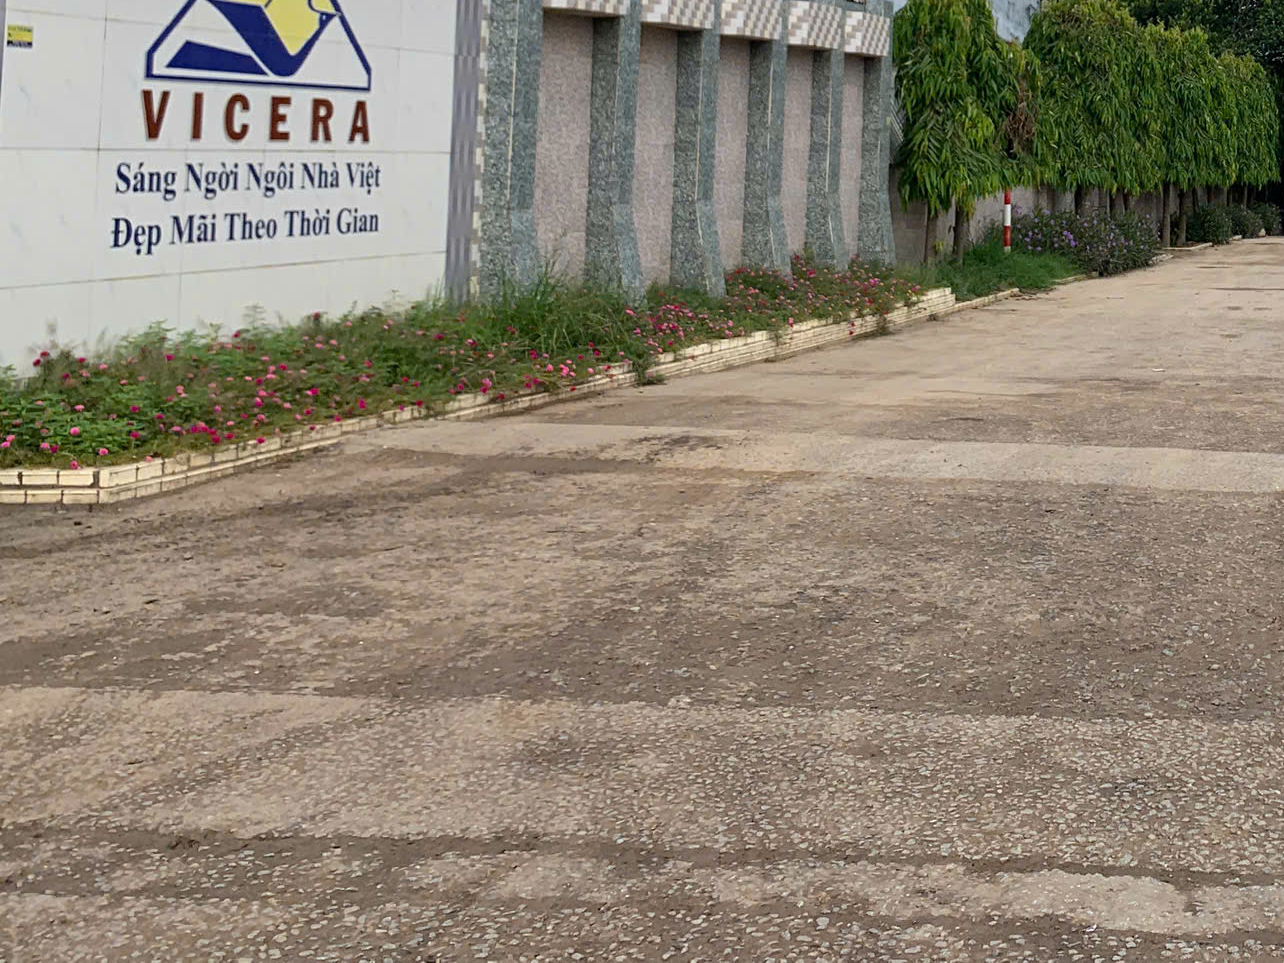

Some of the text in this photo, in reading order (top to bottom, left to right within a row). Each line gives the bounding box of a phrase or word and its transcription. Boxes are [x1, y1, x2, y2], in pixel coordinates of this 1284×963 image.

[141, 89, 370, 144] VICERA
[115, 161, 381, 201] Sáng Ngời Ngôi Nhà Việt
[110, 207, 379, 255] Đẹp Mãi Theo Thời Gian
